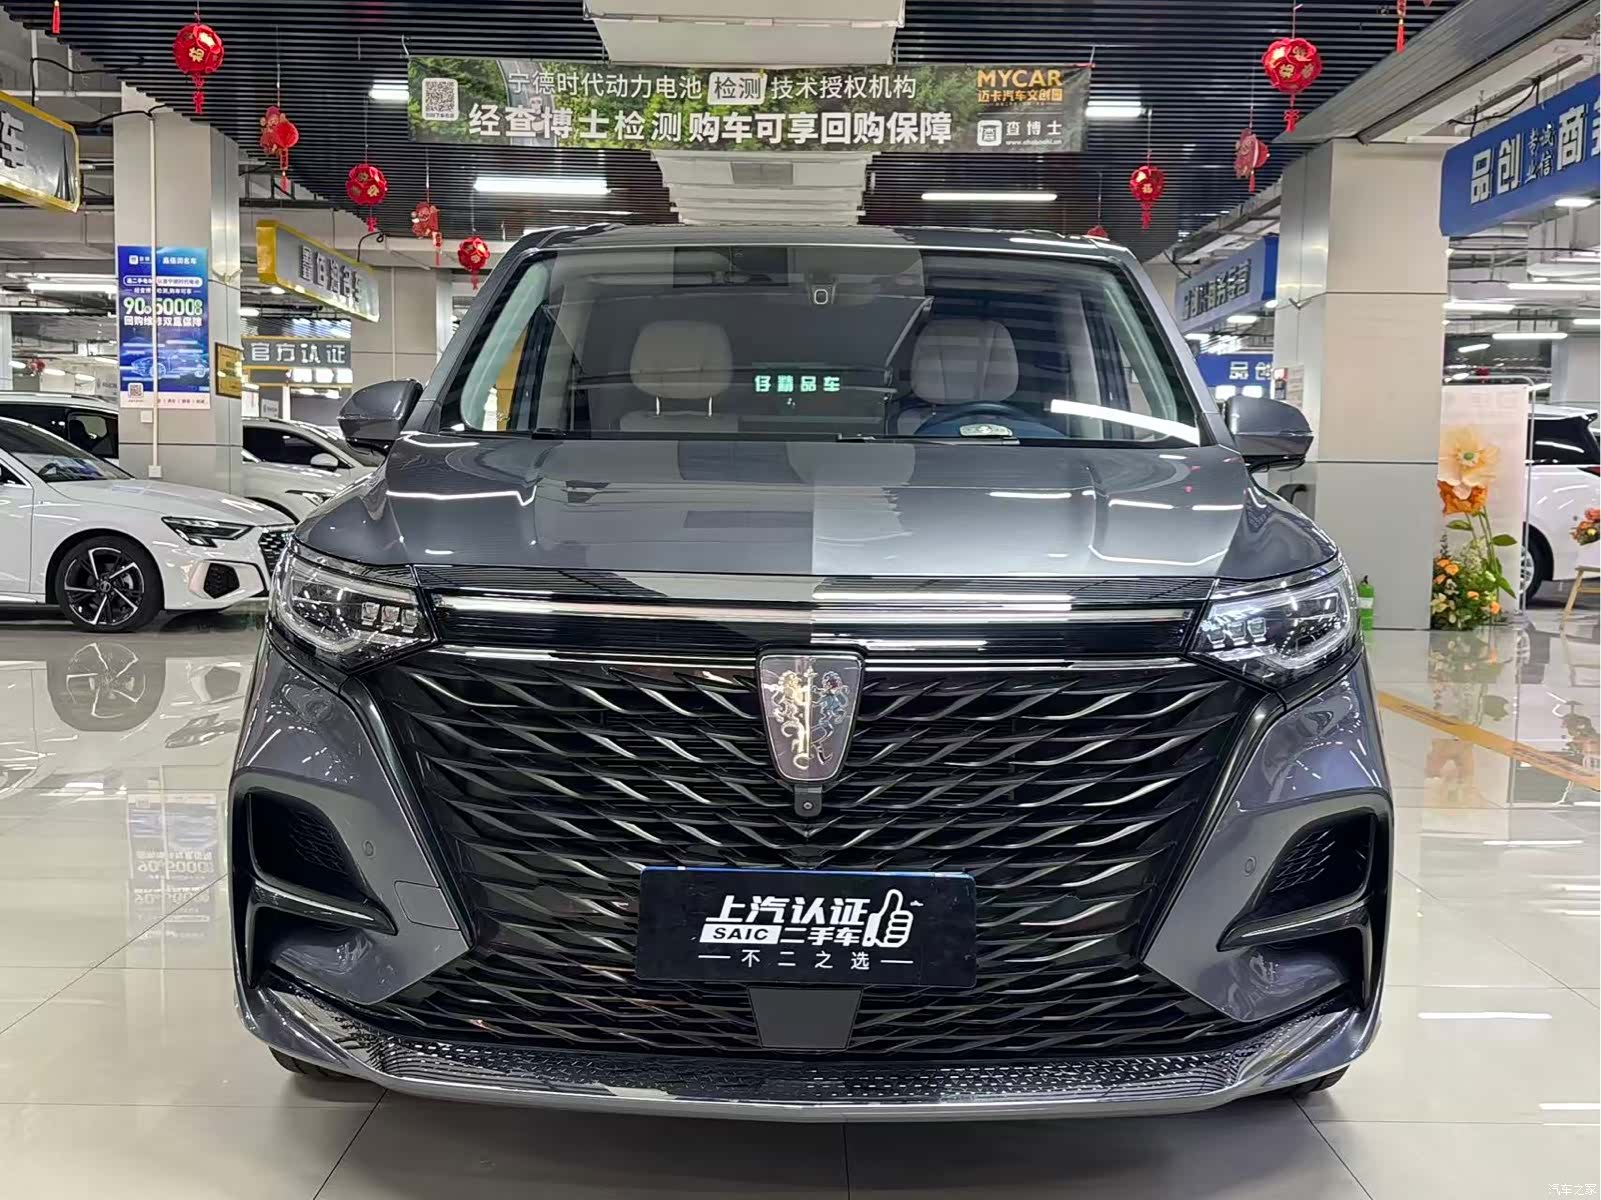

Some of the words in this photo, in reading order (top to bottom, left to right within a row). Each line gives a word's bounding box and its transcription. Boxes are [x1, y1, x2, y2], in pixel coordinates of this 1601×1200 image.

[508, 70, 702, 100] 宁德时代动力电池
[713, 75, 763, 100] 检测
[770, 75, 917, 100] 技术授权机构
[977, 69, 1063, 88] MYCAR
[469, 102, 953, 145] 经查博士检测购车可享回购保障
[1006, 120, 1064, 136] 查博士
[250, 342, 346, 364] 官方认证
[705, 894, 871, 926] 上汽认证
[712, 927, 769, 941] SAIC
[779, 926, 864, 947] 二手车
[740, 949, 871, 971] 不二之选
